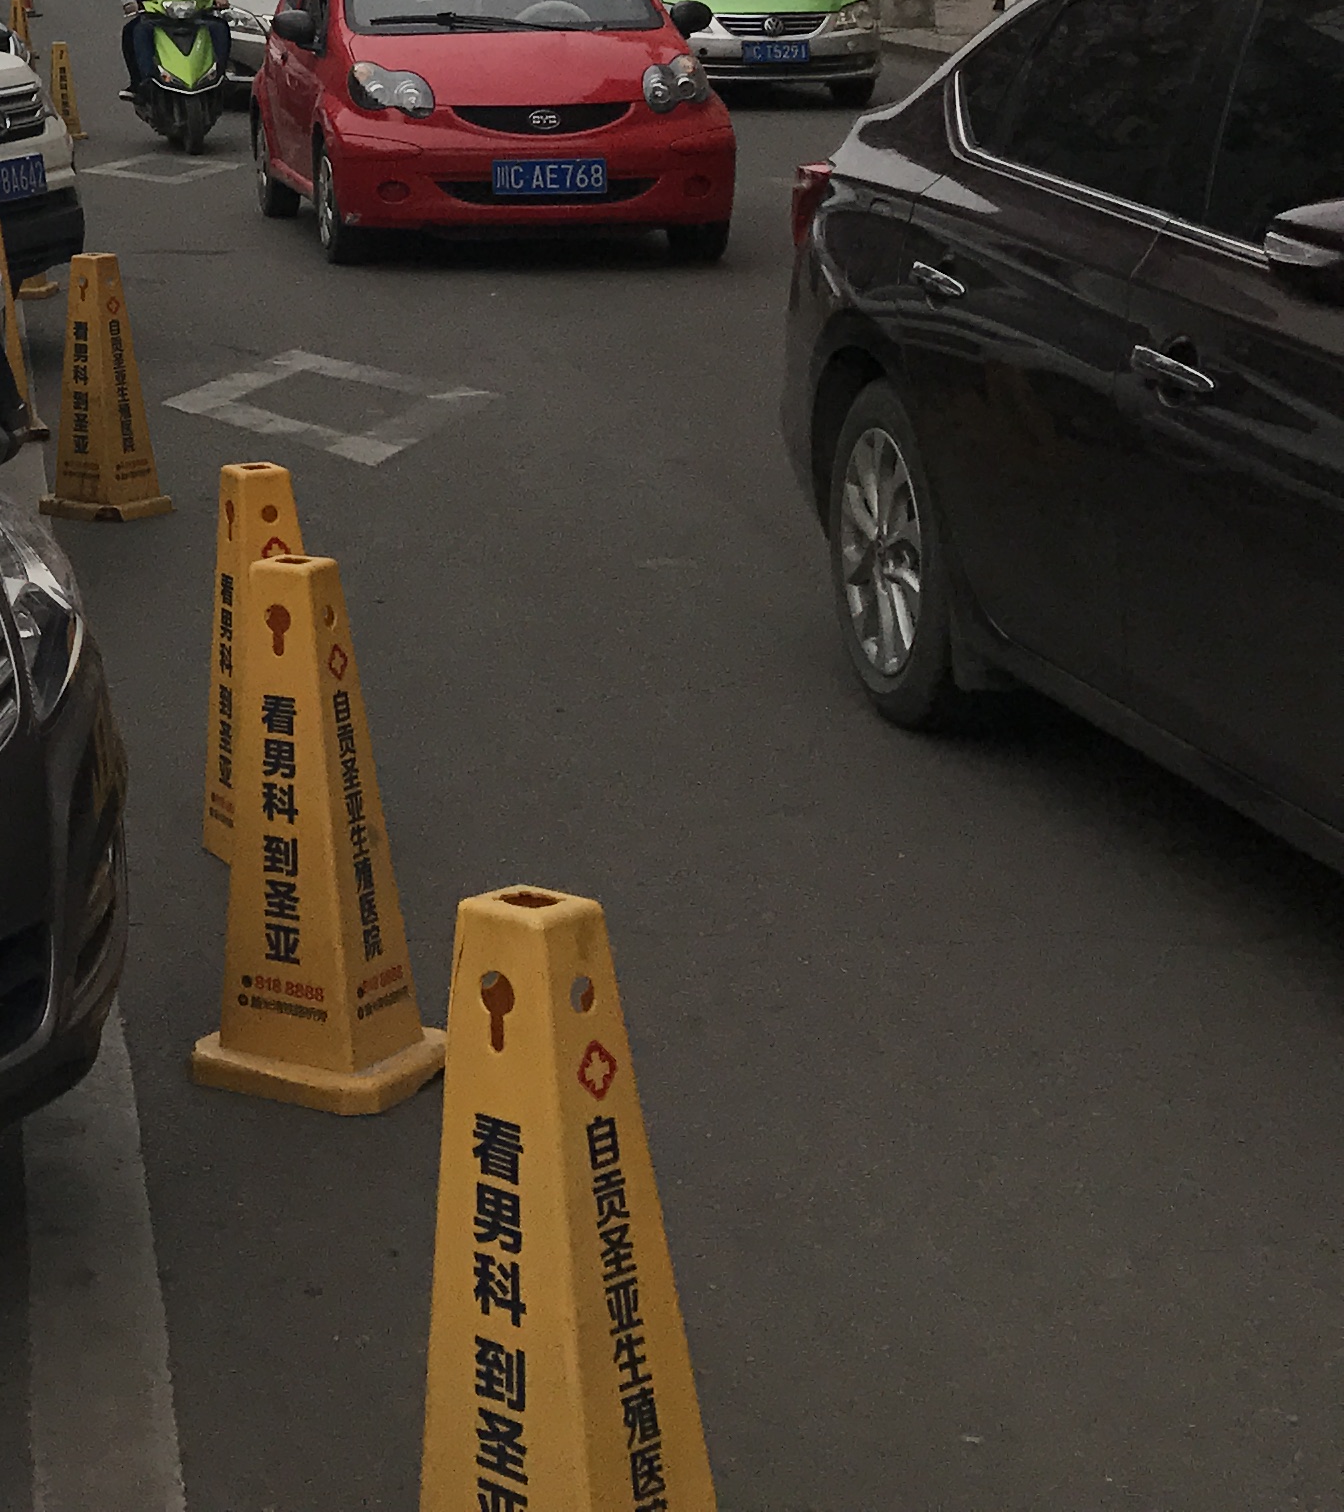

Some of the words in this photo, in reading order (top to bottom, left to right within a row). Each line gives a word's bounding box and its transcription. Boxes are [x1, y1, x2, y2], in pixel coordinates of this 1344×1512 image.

[261, 694, 298, 825] 看男科
[332, 689, 384, 962] 自贡圣亚生殖医院
[263, 835, 301, 965] 到圣亚
[473, 1112, 526, 1328] 看男科
[585, 1115, 668, 1512] 自贡圣亚生殖医
